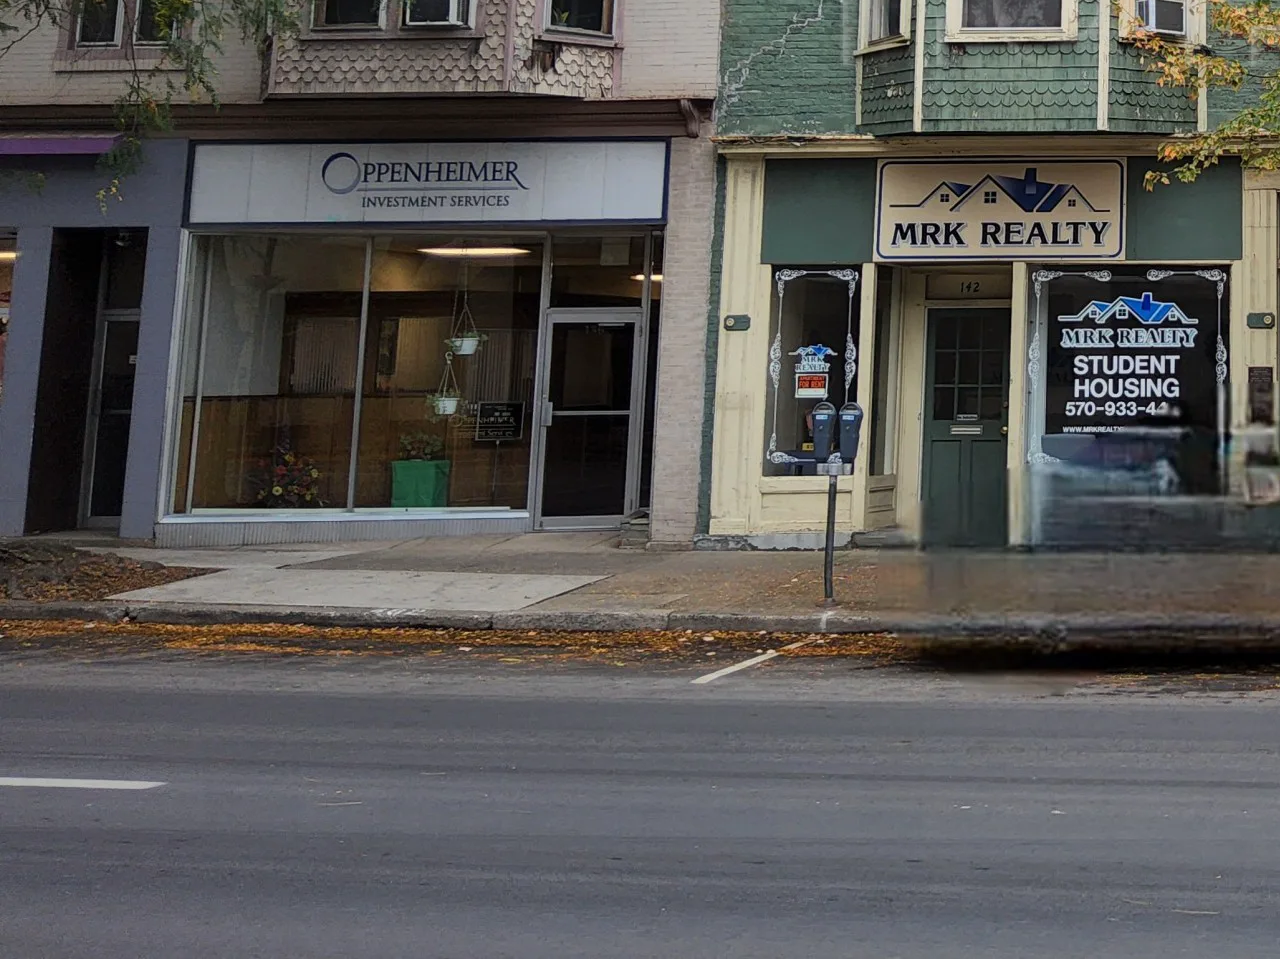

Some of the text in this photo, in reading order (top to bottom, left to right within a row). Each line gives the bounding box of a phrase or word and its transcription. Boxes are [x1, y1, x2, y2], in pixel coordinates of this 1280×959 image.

[321, 152, 529, 195] OPPENHEIMER
[361, 195, 510, 208] INVESTMENT SERVICES
[891, 221, 1110, 247] MRK REALTY
[960, 281, 980, 293] 142
[1060, 328, 1198, 347] MRK REALTY
[1073, 355, 1181, 375] STUDENT
[1073, 378, 1181, 398] HOUSING
